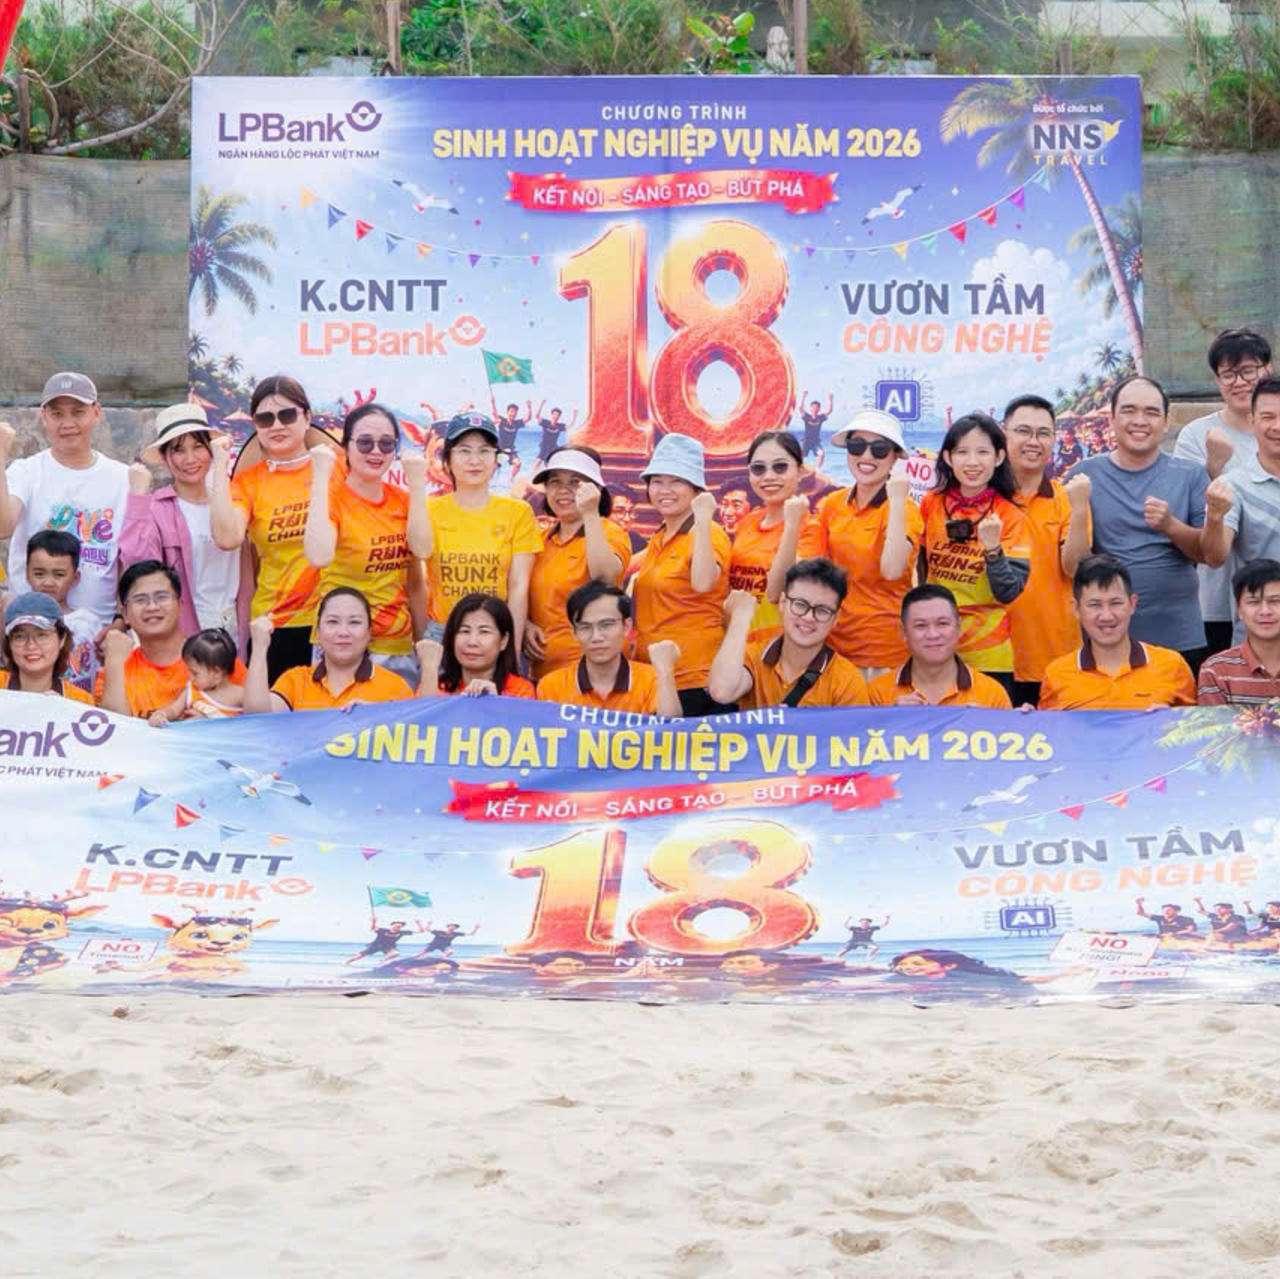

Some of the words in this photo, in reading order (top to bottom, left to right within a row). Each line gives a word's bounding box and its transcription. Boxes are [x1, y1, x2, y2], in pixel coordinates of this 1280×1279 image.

[601, 104, 682, 120] CHƯƠNG
[690, 102, 747, 120] TRÌNH
[218, 113, 346, 142] LPBank
[1033, 123, 1102, 150] NNS
[218, 148, 248, 159] NGÂN
[356, 149, 380, 159] NAM
[432, 127, 507, 158] SINH
[514, 127, 598, 165] HOẠT
[603, 123, 717, 165] NGHIỆP
[721, 127, 765, 165] VỤ
[769, 123, 839, 158] NĂM
[846, 127, 921, 158] 2026
[1033, 154, 1108, 166] TRAVEL
[532, 184, 568, 205] KẾT
[623, 183, 672, 204] SÁNG
[676, 181, 710, 202] TẠO
[728, 178, 763, 197] BỨT
[767, 177, 805, 197] PHÁ
[299, 278, 448, 313] K.CNTT
[840, 279, 950, 316] VƯƠN
[963, 273, 1045, 316] TẦM
[298, 322, 448, 356] LPBank
[558, 219, 797, 458] 18
[842, 316, 945, 354] CÔNG
[954, 316, 1055, 362] NGHỆ
[883, 387, 911, 412] AI
[905, 461, 932, 481] NO
[439, 551, 500, 565] LPBANK
[929, 552, 984, 574] RUN4
[440, 565, 498, 583] RUN4
[930, 567, 978, 585] HANGE
[324, 722, 438, 764] SINH
[448, 726, 567, 777] HOẠT
[577, 723, 749, 781] NGHIỆP
[756, 734, 818, 777] VỤ
[829, 728, 931, 768] NĂM
[942, 729, 1054, 762] 2026
[484, 795, 527, 818] KẾT
[536, 797, 579, 818] NỐI
[604, 794, 673, 816] SÁNG
[680, 792, 726, 812] TẠO
[808, 779, 858, 798] PHÁ
[84, 842, 294, 877] K.CNTT
[952, 837, 1109, 870] VƯƠN
[1125, 825, 1246, 861] TẦM
[72, 867, 273, 902] LPBank
[503, 816, 820, 955] 18
[956, 869, 1103, 898] CÔNG
[1118, 855, 1259, 889] NGHỆ
[1010, 911, 1045, 927] AI
[101, 943, 141, 954] NO
[1089, 937, 1128, 950] NO
